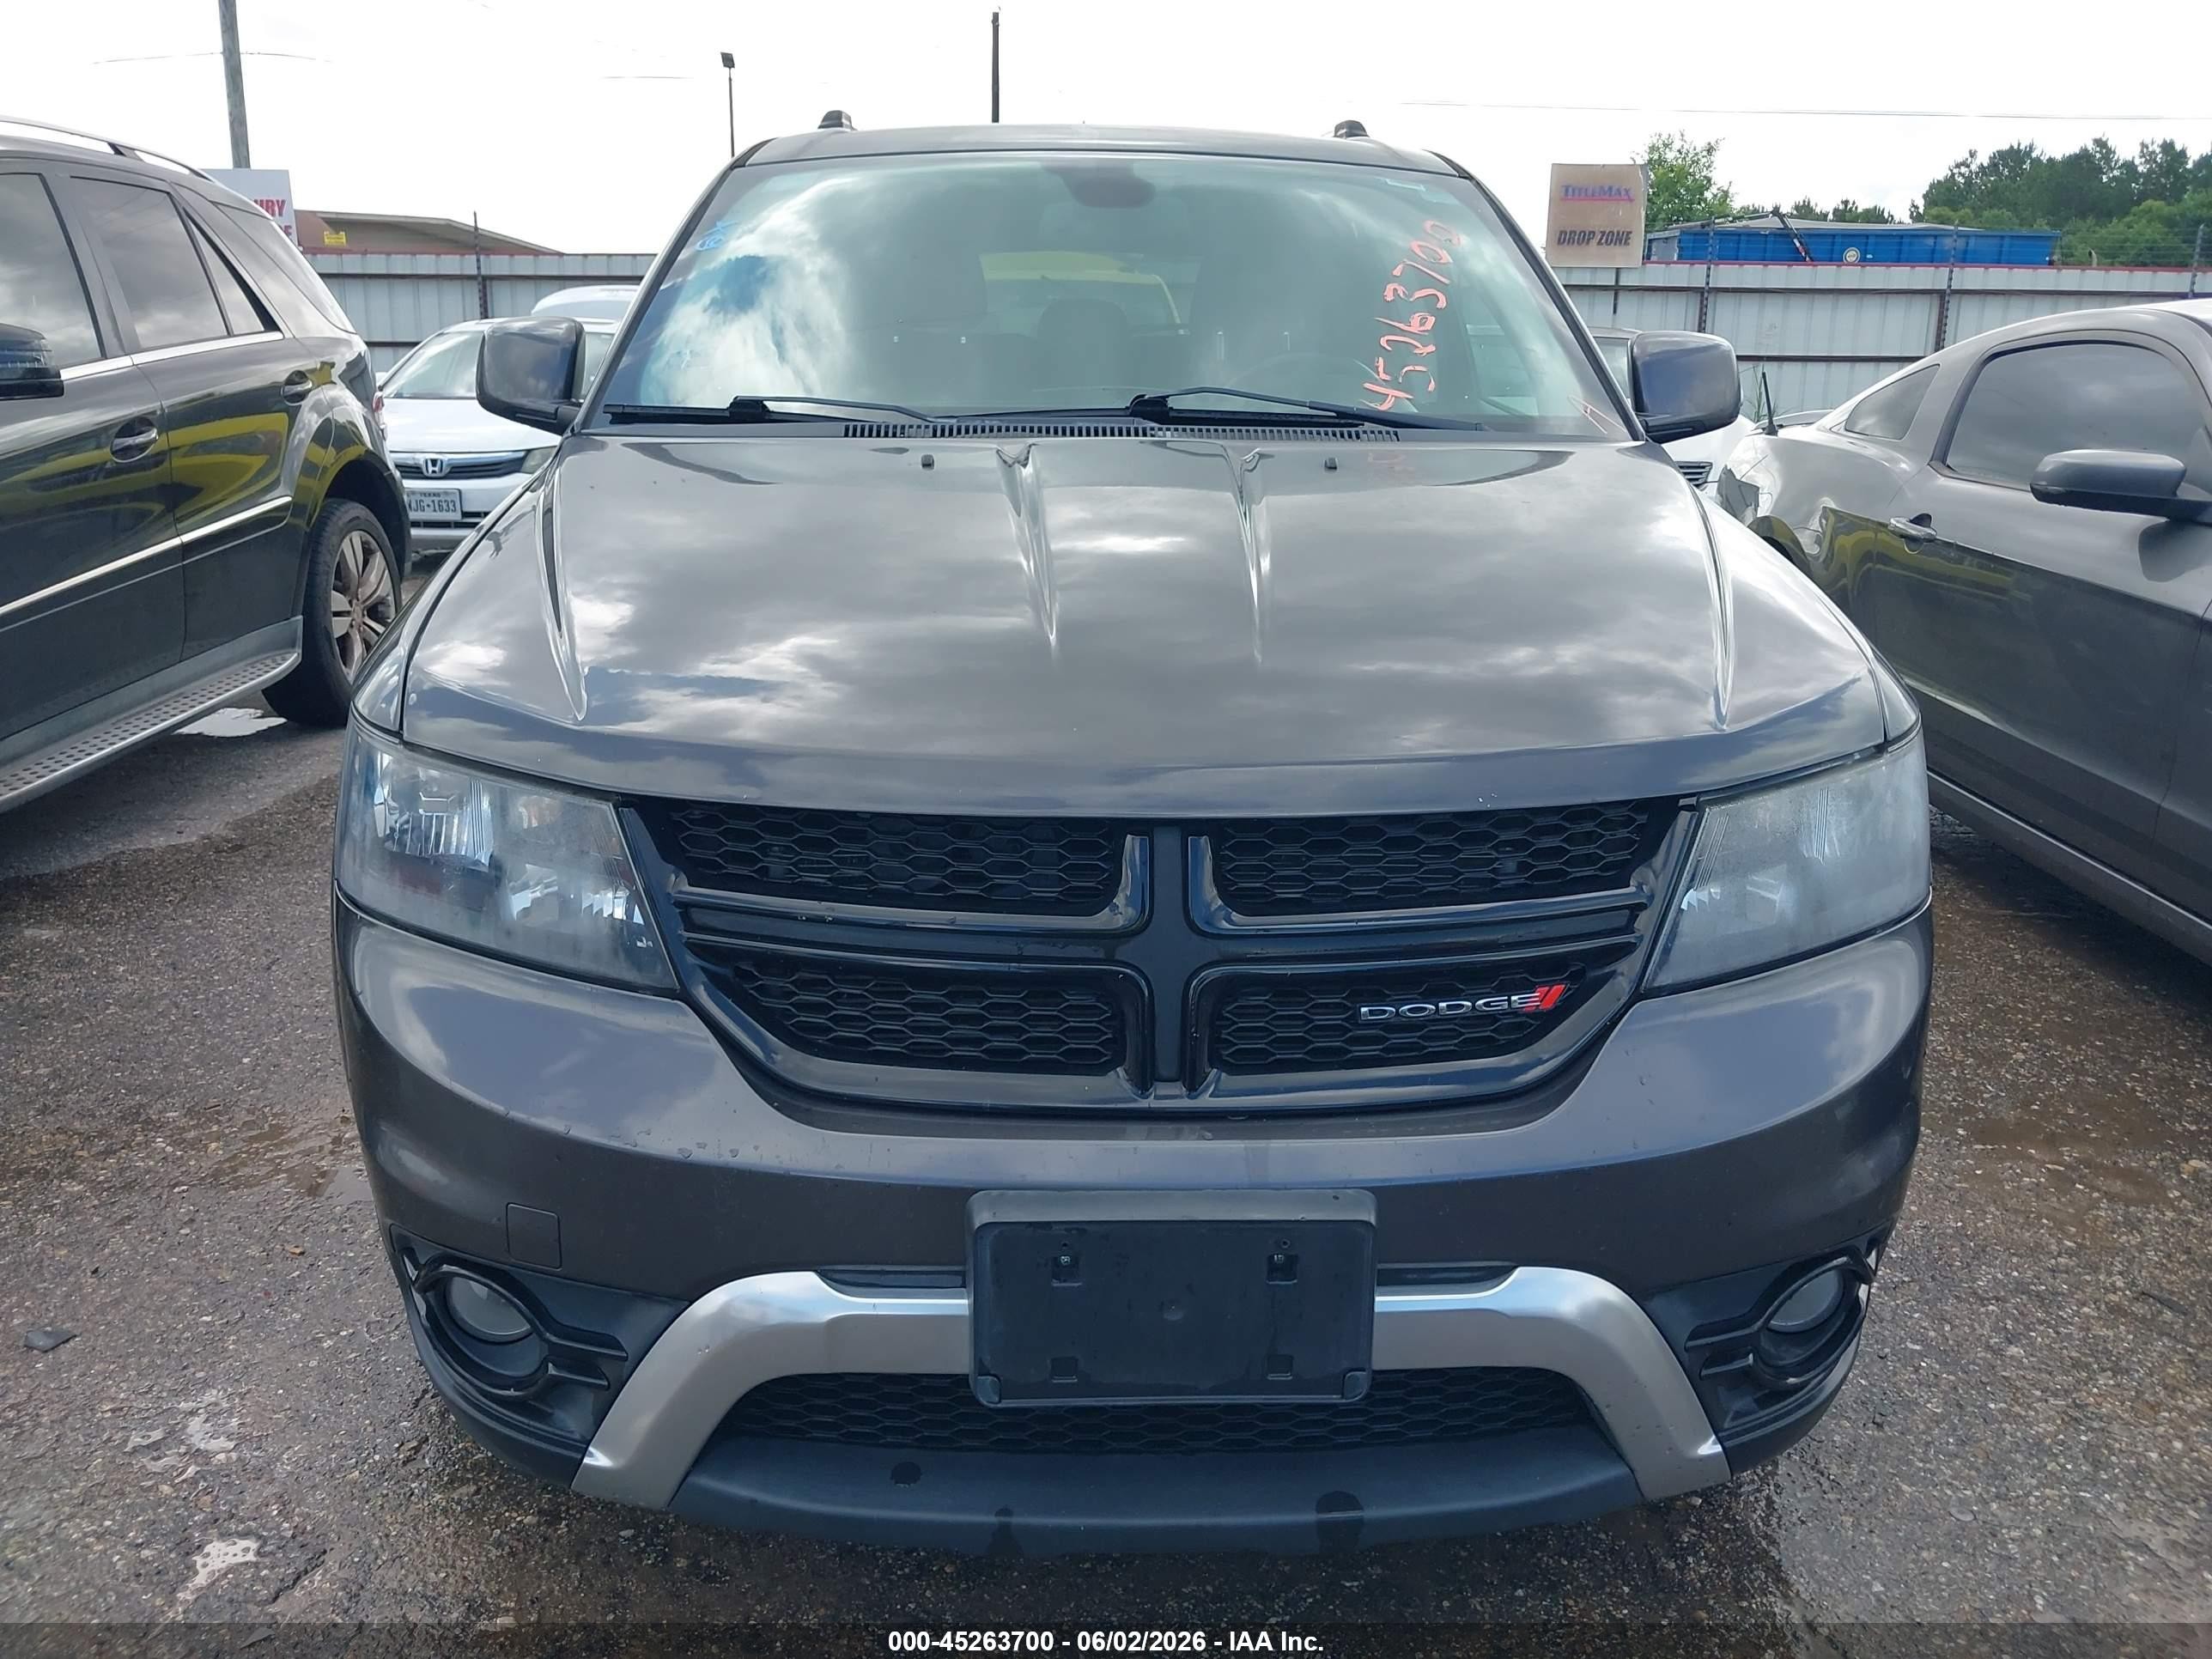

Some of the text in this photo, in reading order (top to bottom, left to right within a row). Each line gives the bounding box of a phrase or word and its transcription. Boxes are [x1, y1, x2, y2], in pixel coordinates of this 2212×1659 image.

[1557, 229, 1633, 246] DROP ZONE
[1360, 993, 1540, 1020] DODGE
